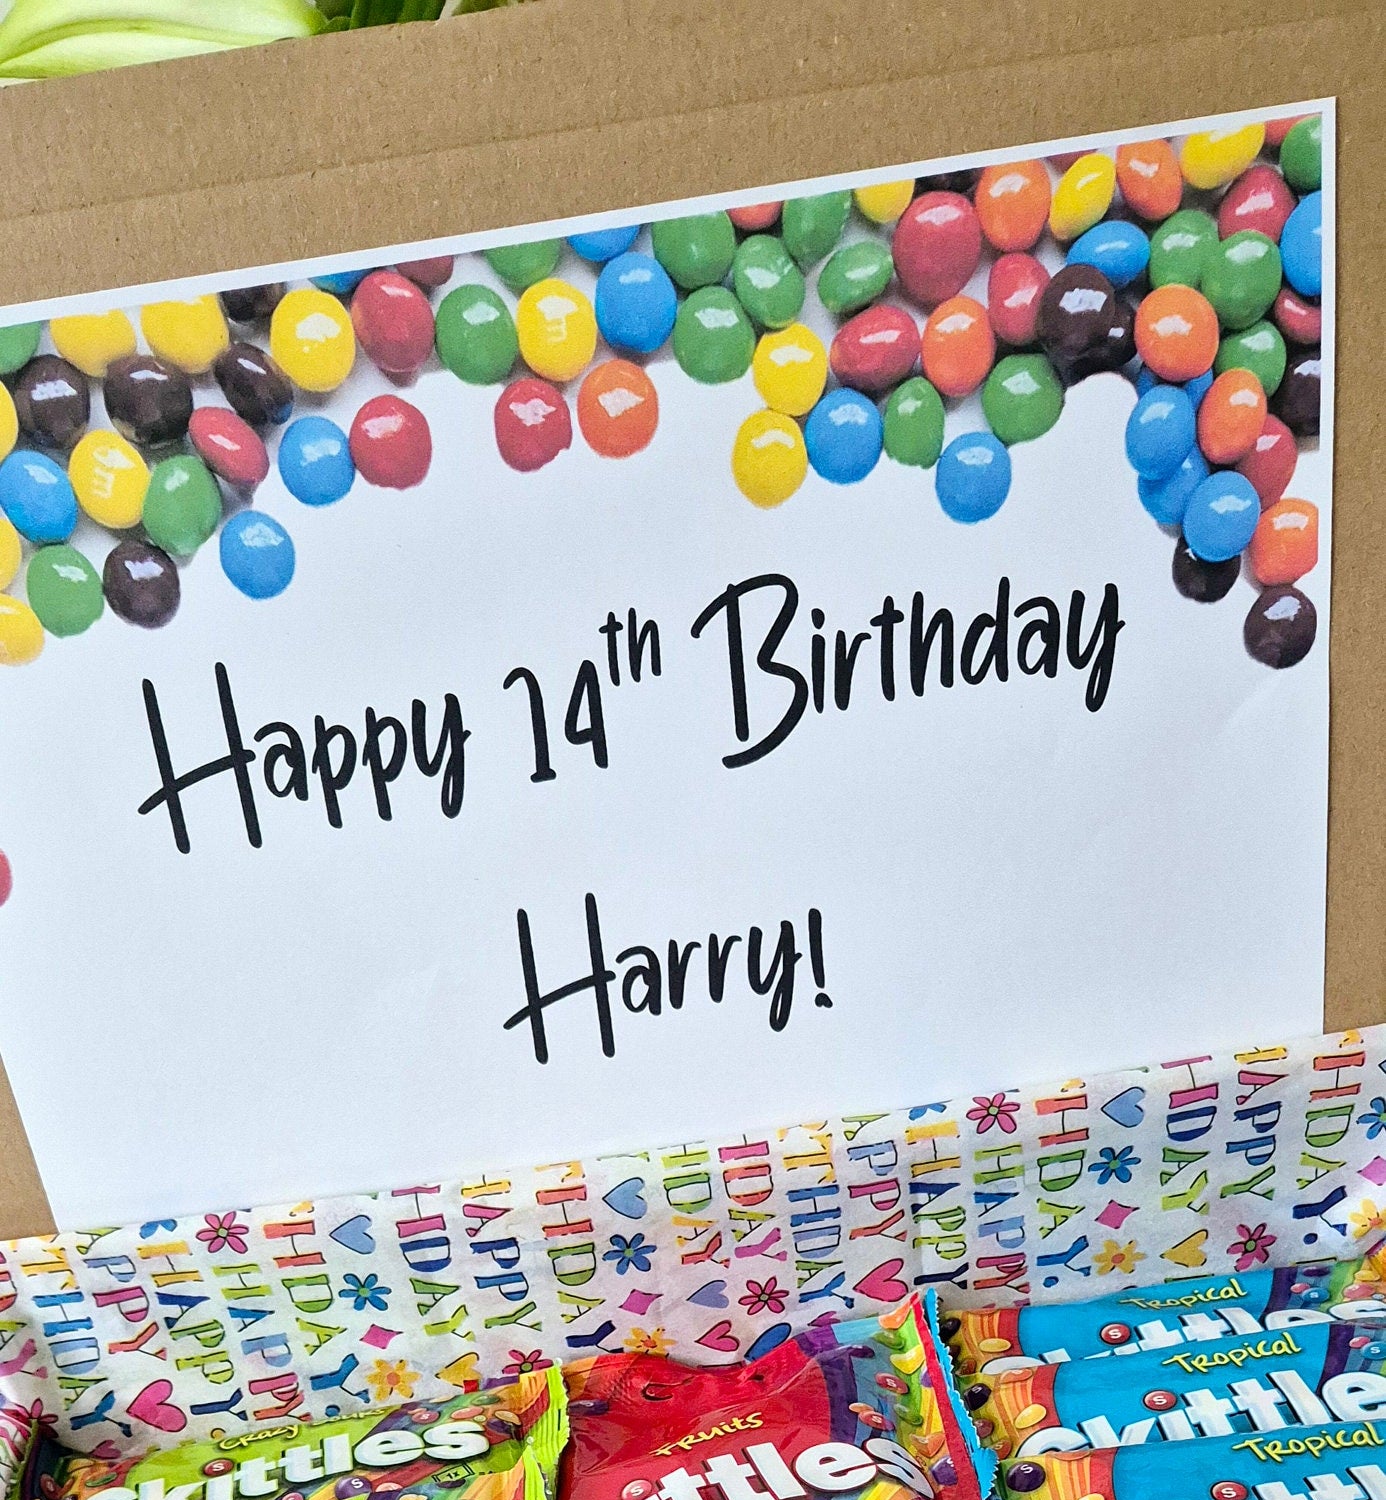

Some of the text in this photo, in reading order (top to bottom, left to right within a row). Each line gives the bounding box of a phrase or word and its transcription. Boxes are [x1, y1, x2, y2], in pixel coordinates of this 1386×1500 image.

[138, 572, 1126, 854] Happy 14th Birthday
[503, 891, 833, 1065] Harry!
[1119, 1279, 1248, 1310] Tropical
[1162, 1333, 1303, 1374] Tropical
[650, 1412, 764, 1457] Fruits
[1234, 1421, 1385, 1465] Tropical
